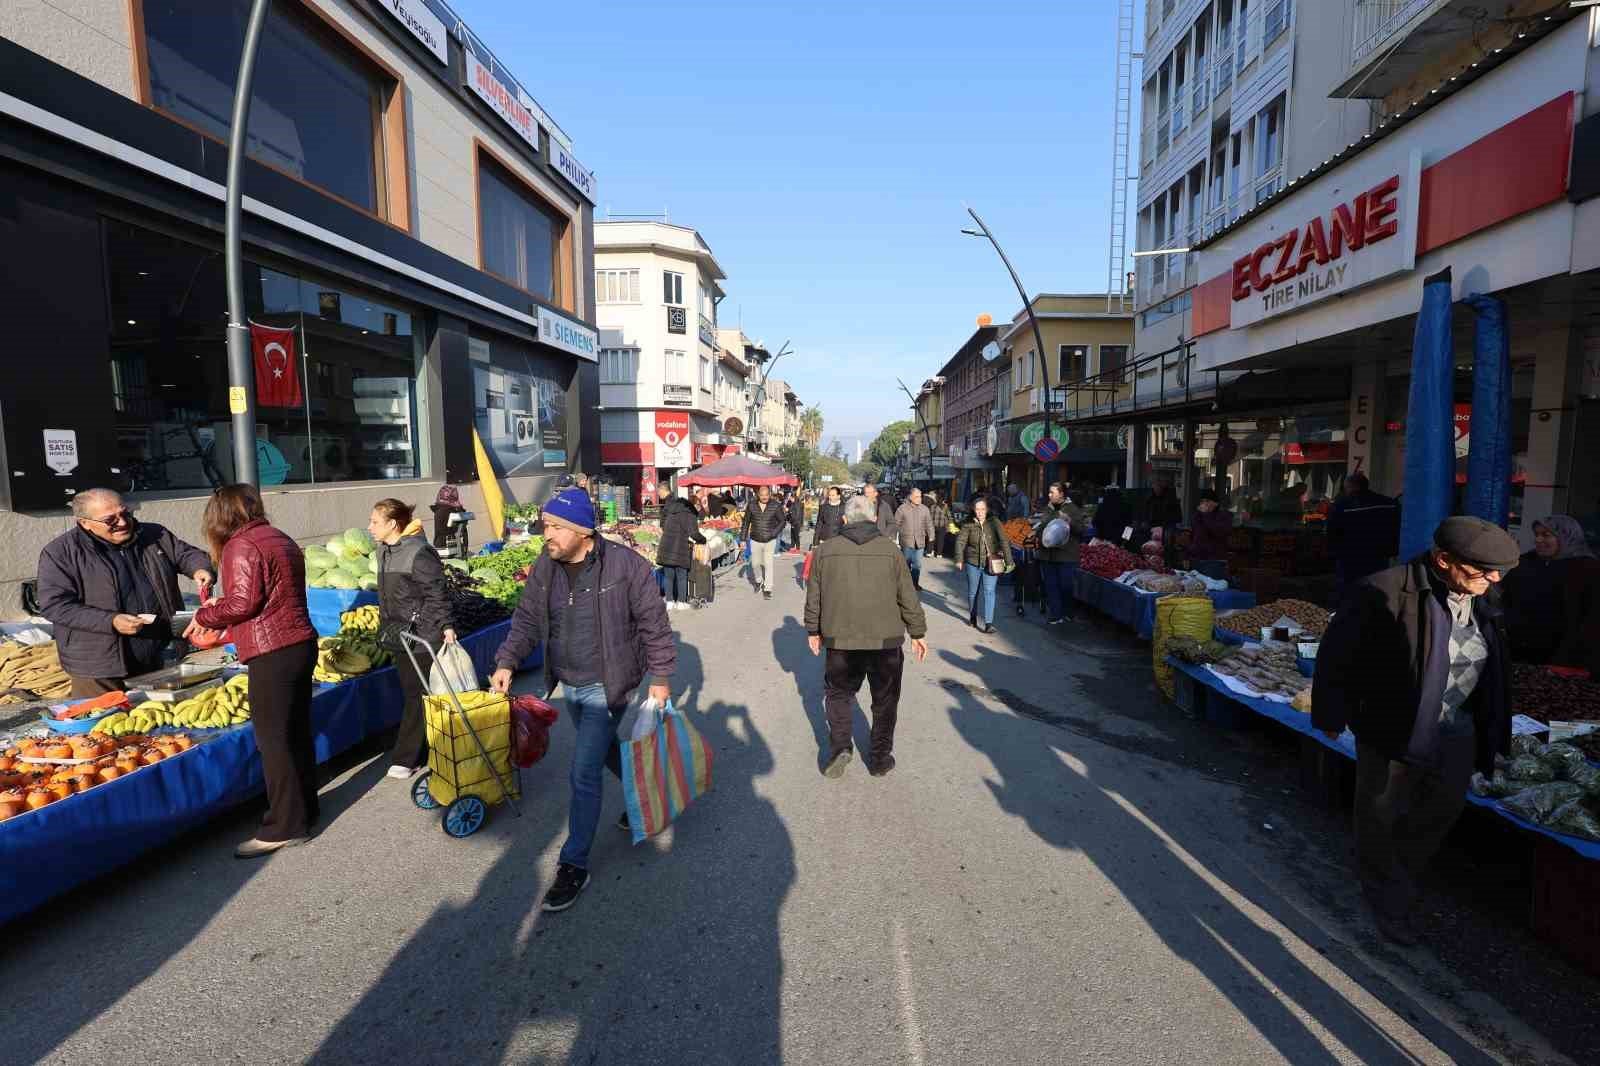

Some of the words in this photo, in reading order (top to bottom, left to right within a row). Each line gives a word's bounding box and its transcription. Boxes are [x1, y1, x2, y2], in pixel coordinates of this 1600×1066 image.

[476, 63, 531, 131] SILVERLINE
[559, 151, 590, 193] PHILIPS
[1231, 174, 1400, 302] ECZANE
[554, 322, 594, 353] SIEMENS
[656, 420, 688, 429] vodafone
